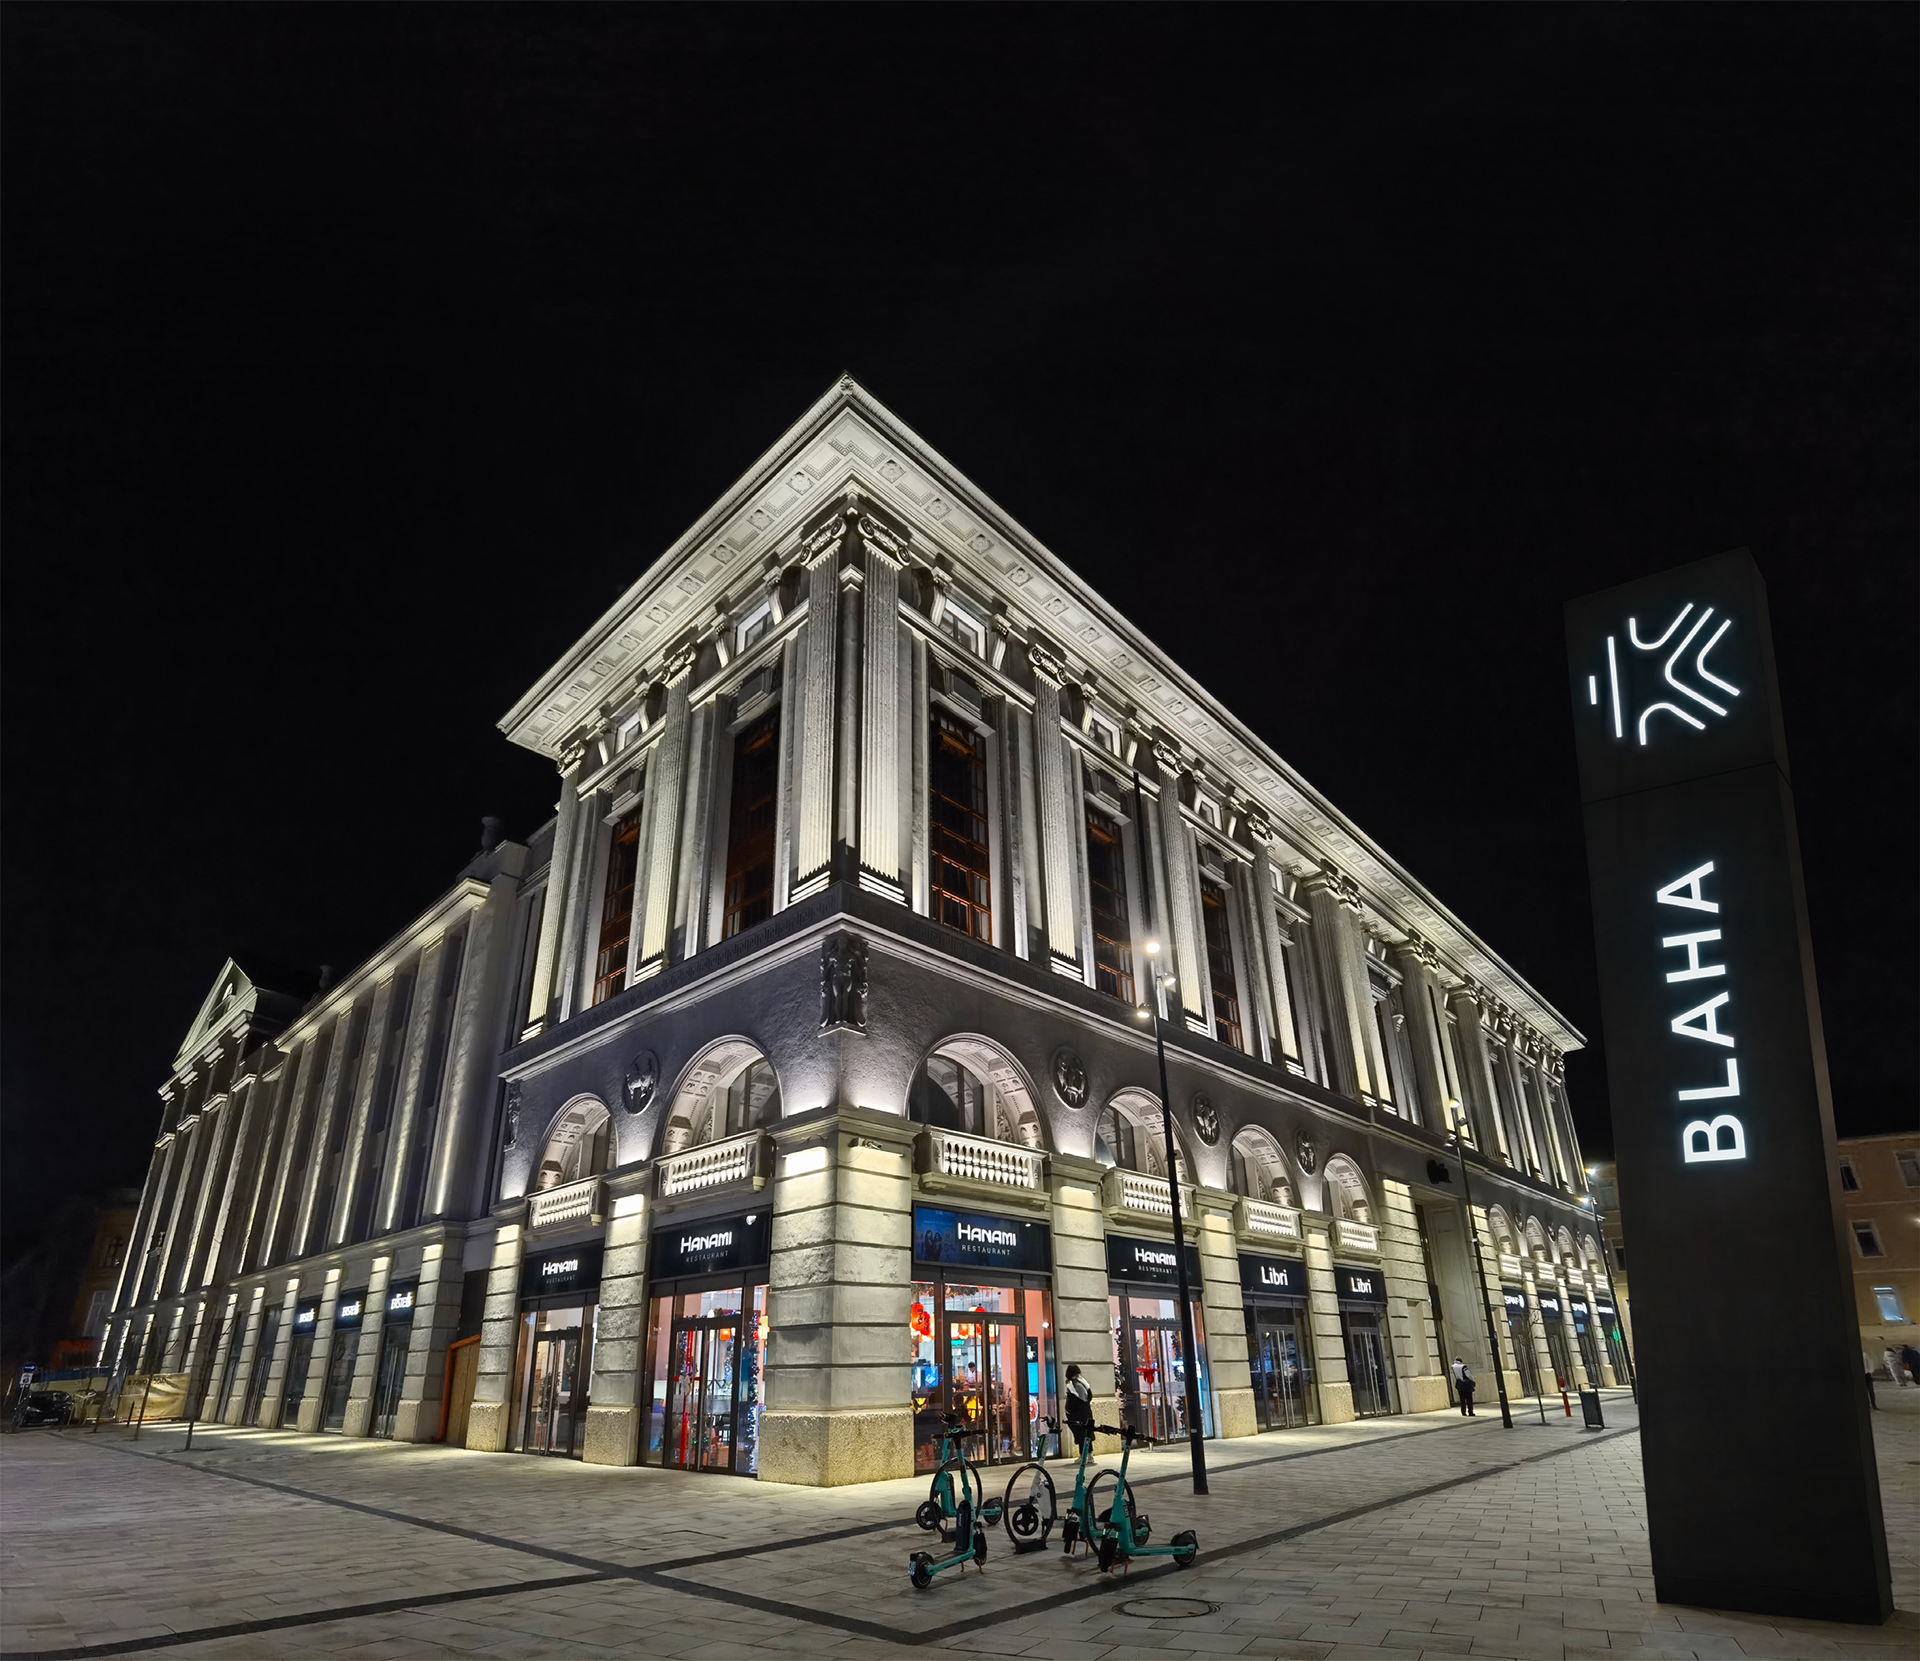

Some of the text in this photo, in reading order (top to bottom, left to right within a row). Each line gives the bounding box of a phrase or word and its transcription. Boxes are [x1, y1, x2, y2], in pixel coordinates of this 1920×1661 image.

[1655, 860, 1748, 1164] BLAHA
[680, 1231, 733, 1254] HANAMI
[957, 1222, 1017, 1246] HANAMI
[685, 1250, 729, 1263] RESTAURANT
[961, 1244, 1011, 1256] RESTAURANT
[1260, 1265, 1289, 1286] Libri
[1350, 1276, 1373, 1294] Libri
